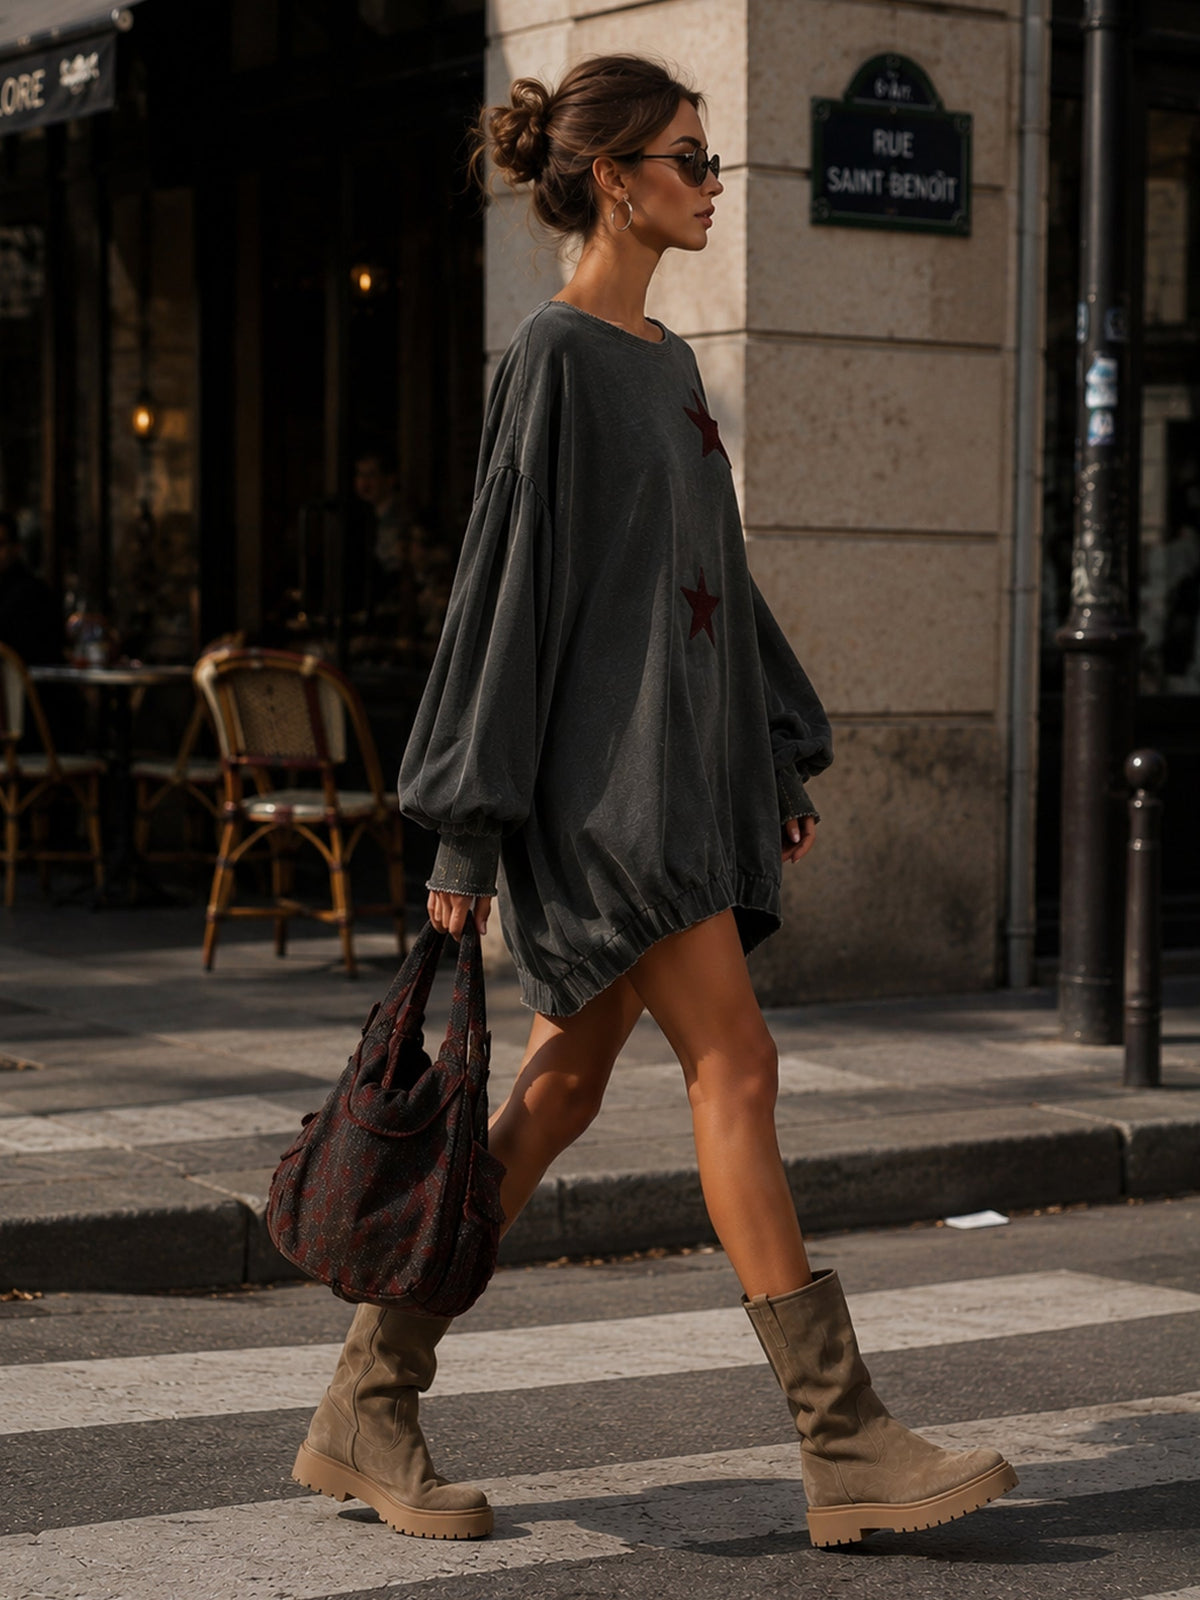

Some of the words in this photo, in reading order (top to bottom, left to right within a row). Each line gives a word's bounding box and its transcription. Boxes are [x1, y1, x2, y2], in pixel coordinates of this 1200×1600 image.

[0, 68, 45, 116] ORE
[872, 128, 915, 159] RUE
[826, 165, 885, 196] SAINT
